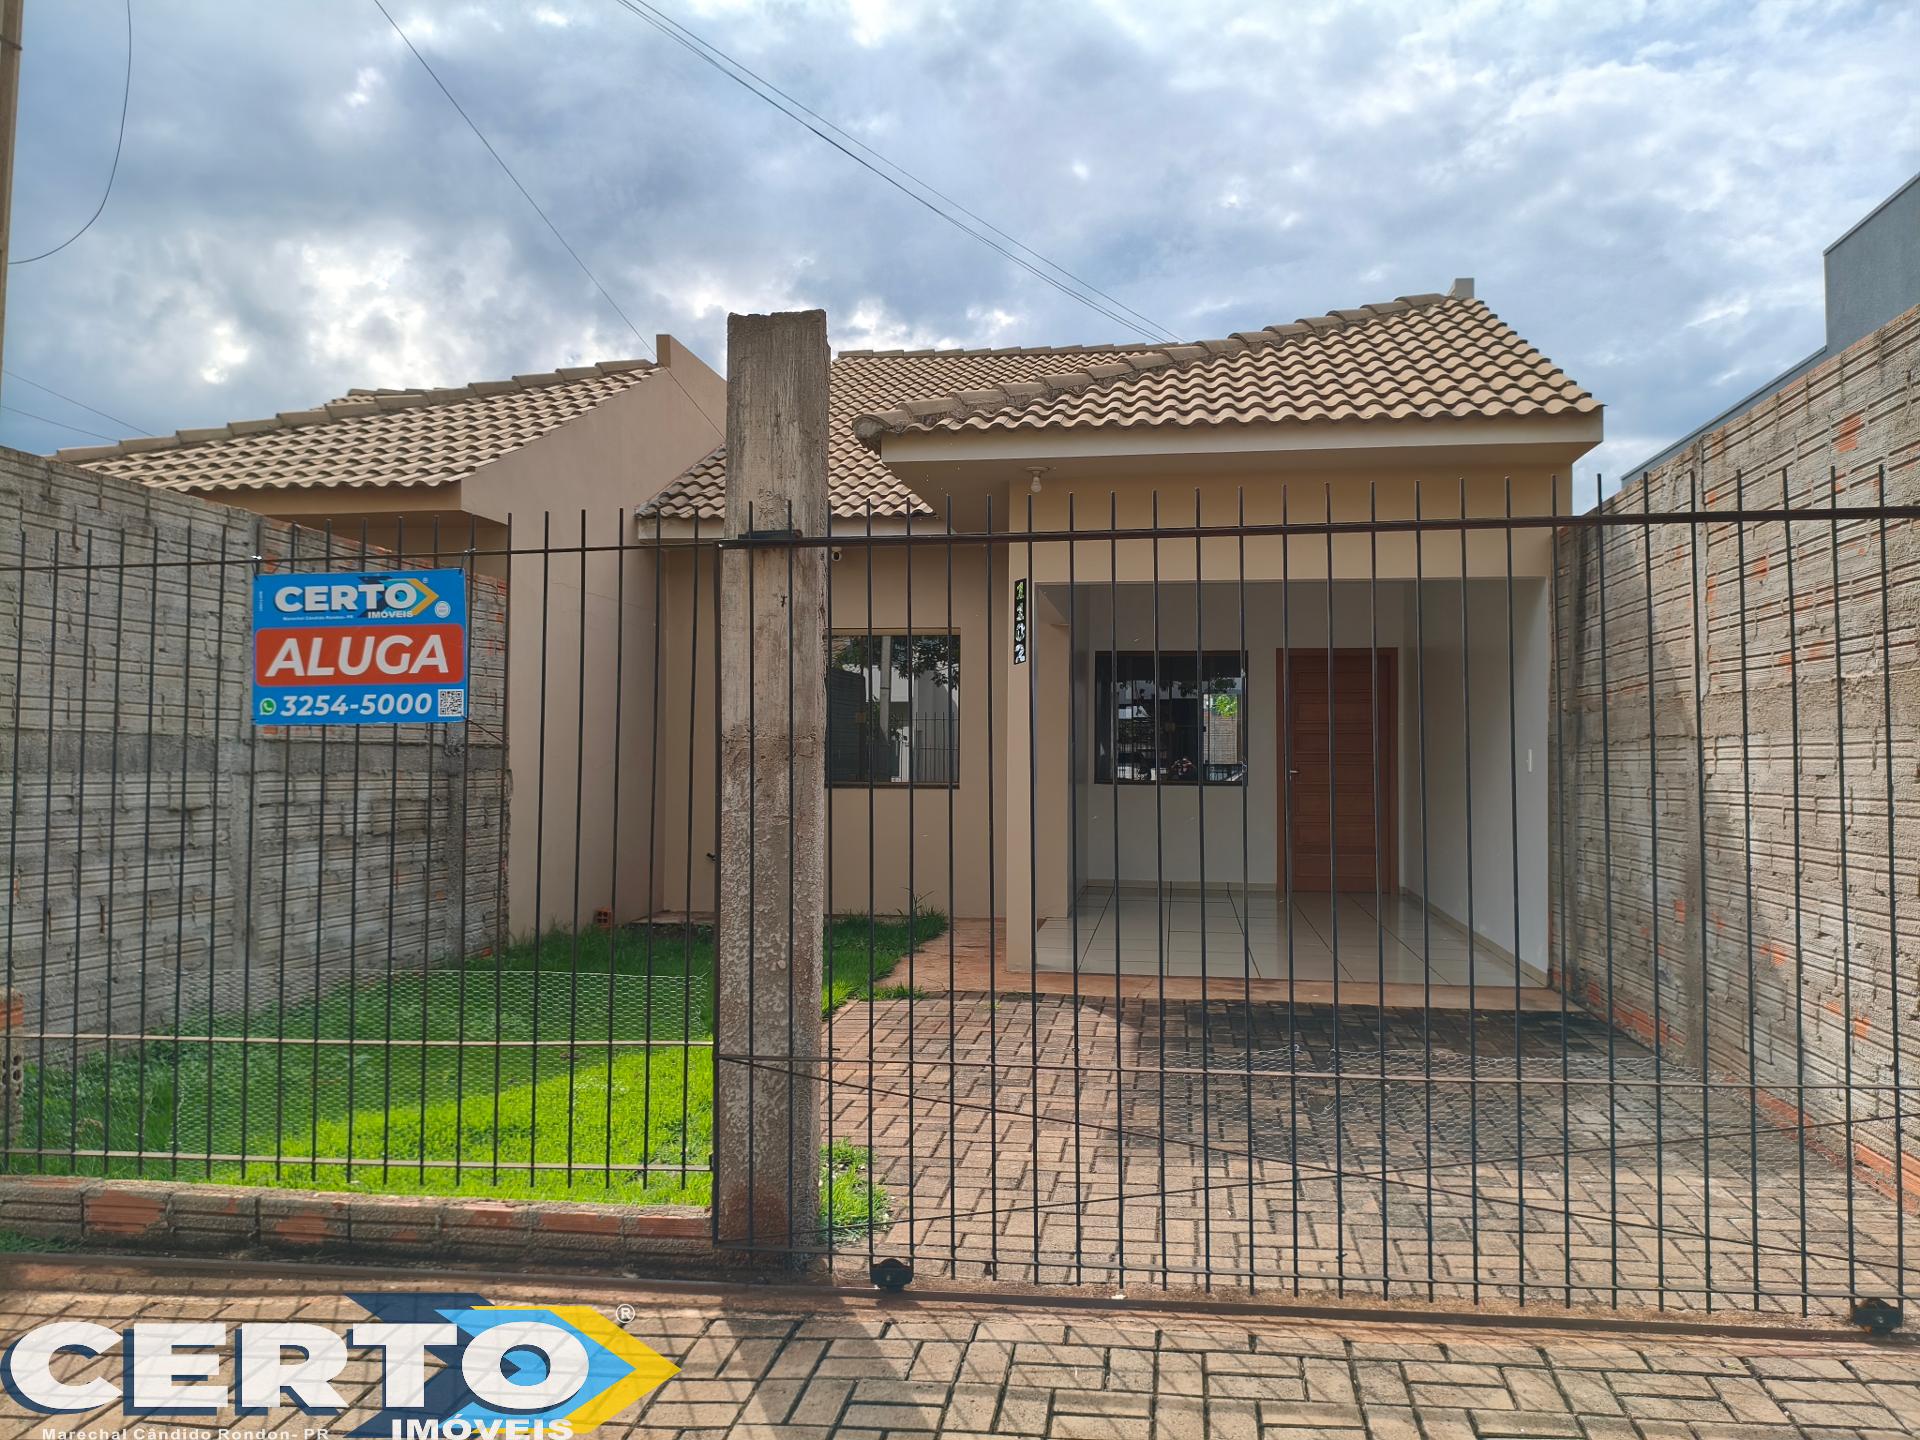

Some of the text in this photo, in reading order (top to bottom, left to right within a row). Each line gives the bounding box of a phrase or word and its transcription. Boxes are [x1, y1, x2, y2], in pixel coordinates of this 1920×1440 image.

[274, 582, 418, 613] CERTO
[367, 608, 414, 619] IMÓVEIS
[264, 634, 449, 677] ALUGA
[280, 693, 432, 717] 3254-5000
